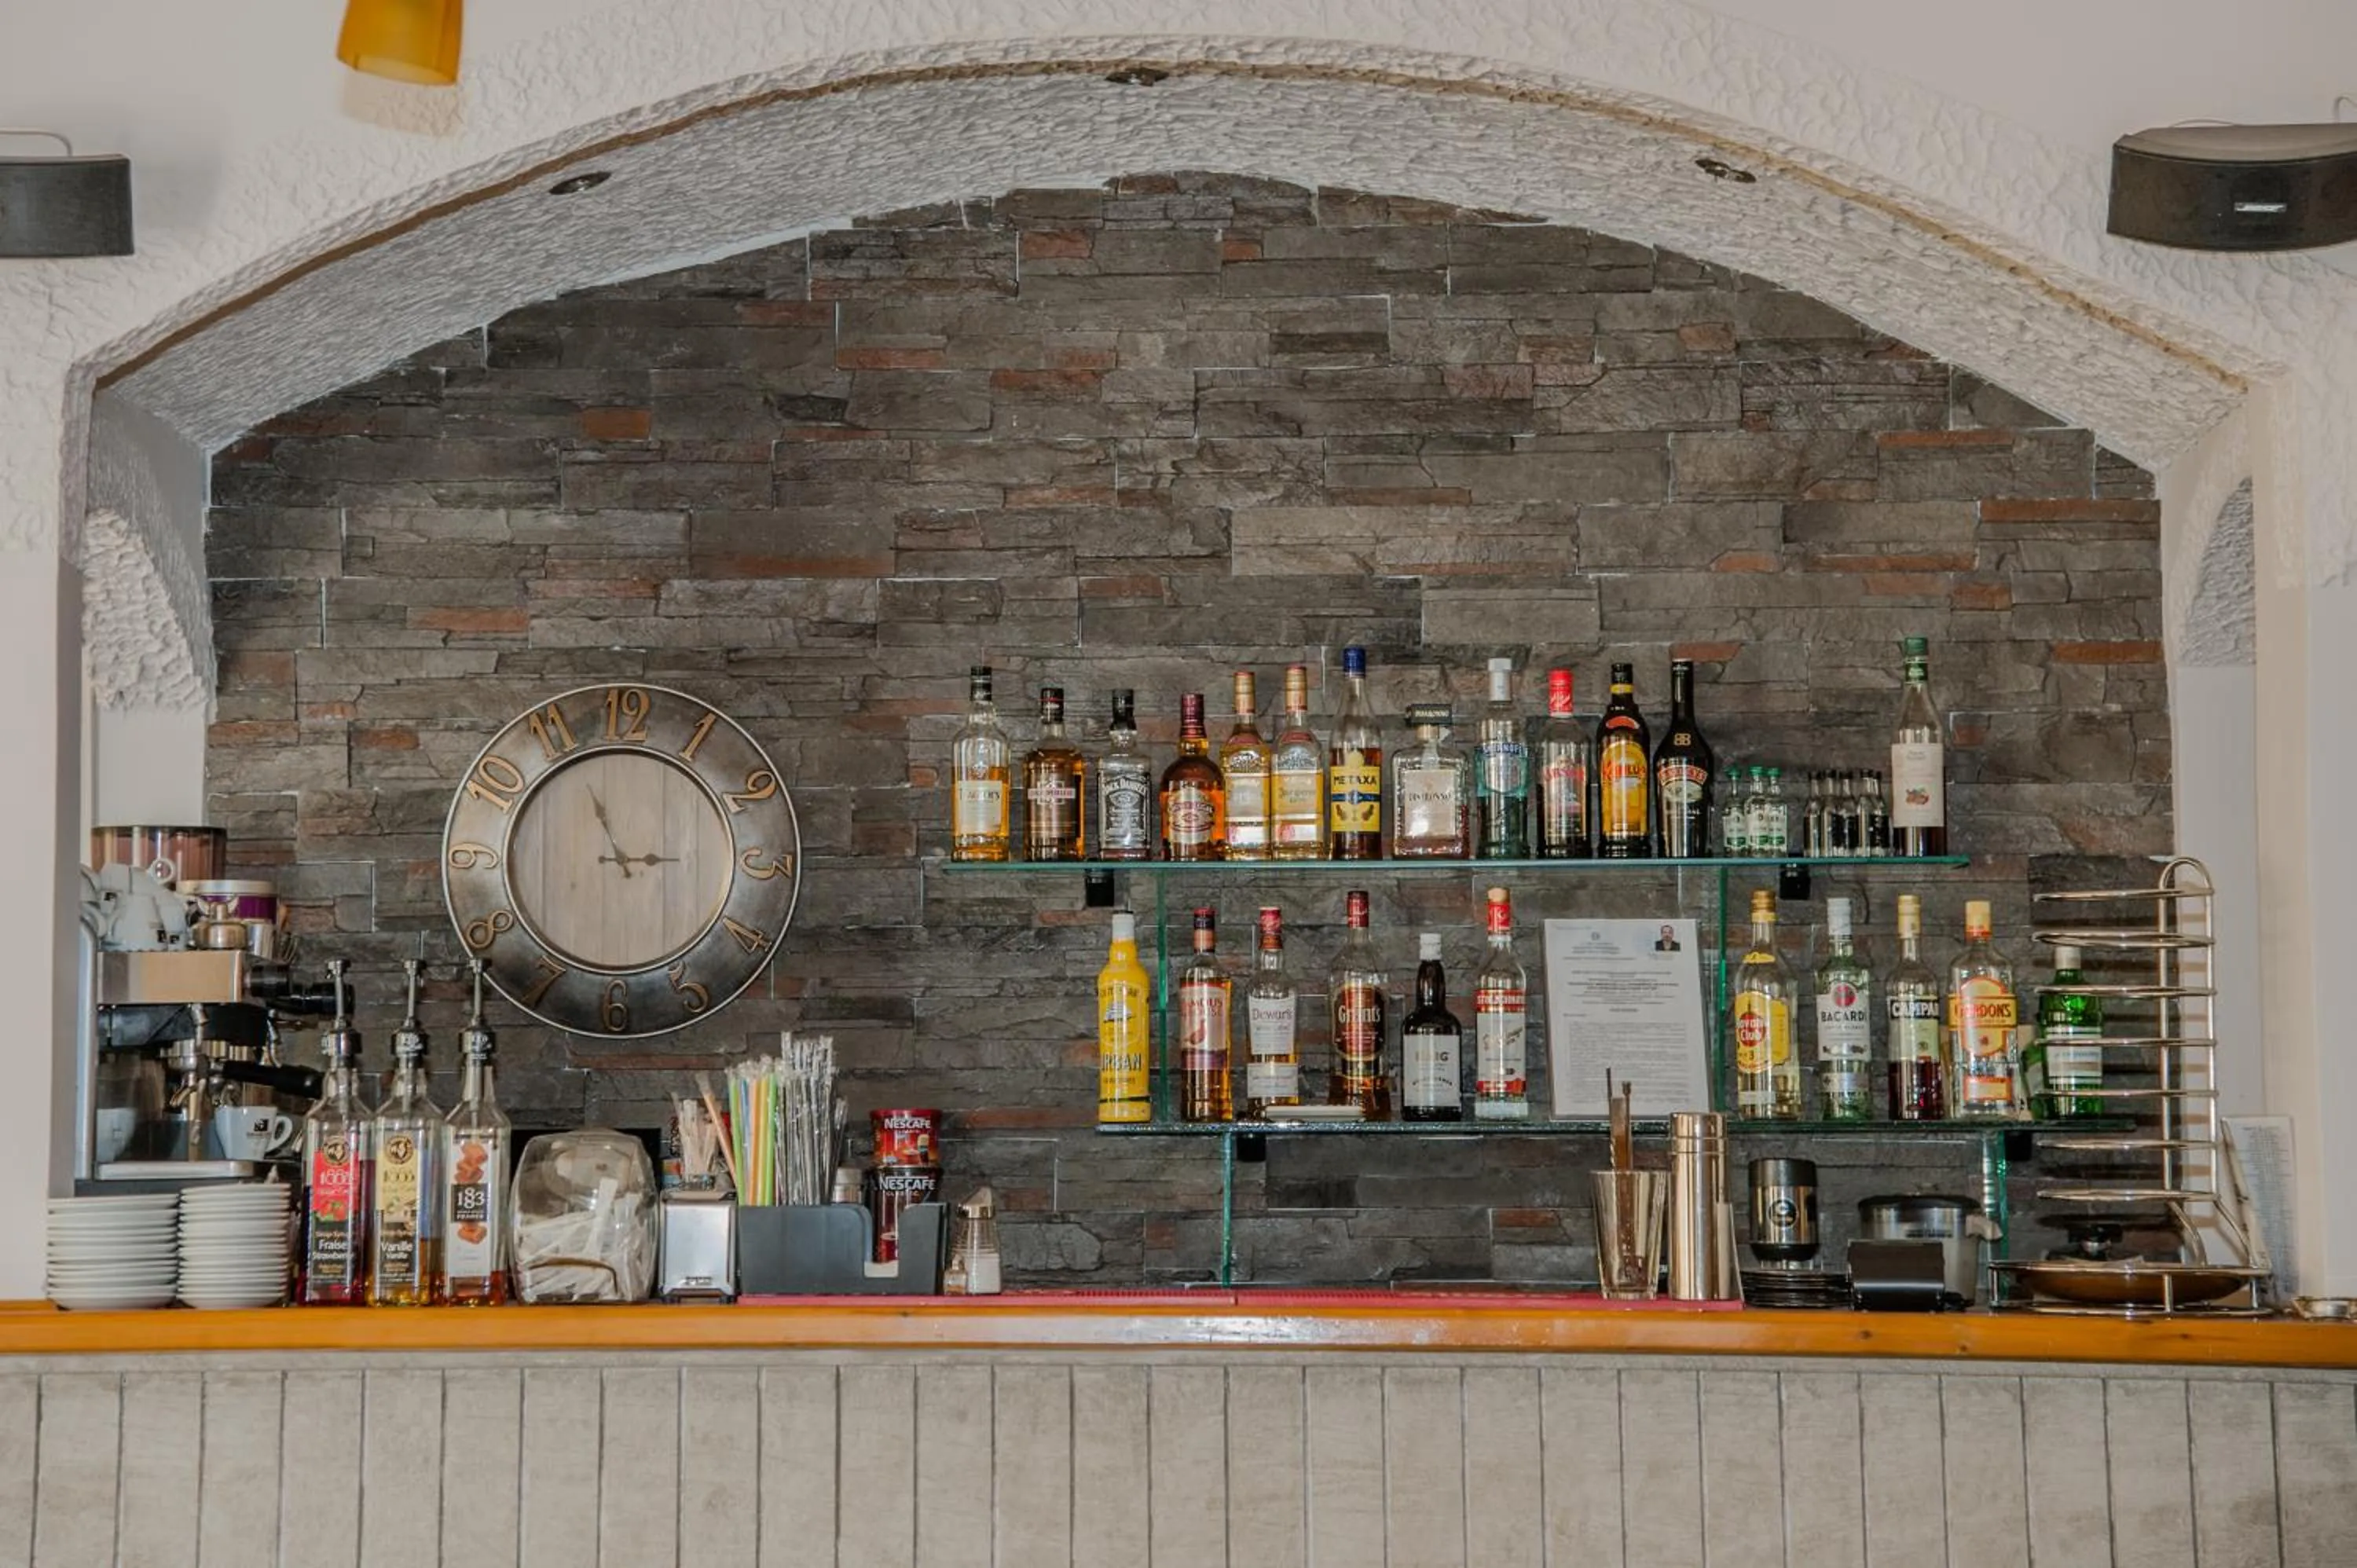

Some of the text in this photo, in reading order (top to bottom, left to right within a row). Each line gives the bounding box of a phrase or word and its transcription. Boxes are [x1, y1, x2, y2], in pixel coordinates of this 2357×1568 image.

[529, 702, 577, 760] 11
[603, 688, 651, 742] 12
[679, 712, 716, 762] 1
[467, 754, 524, 814] 10
[723, 769, 776, 813] 2
[449, 842, 499, 869] 9
[740, 846, 793, 880] 3
[467, 910, 513, 950] 8
[723, 916, 773, 955] 4
[520, 955, 566, 1008] 7
[602, 979, 629, 1032] 6
[668, 960, 712, 1013] 5
[458, 1187, 485, 1209] 1883
